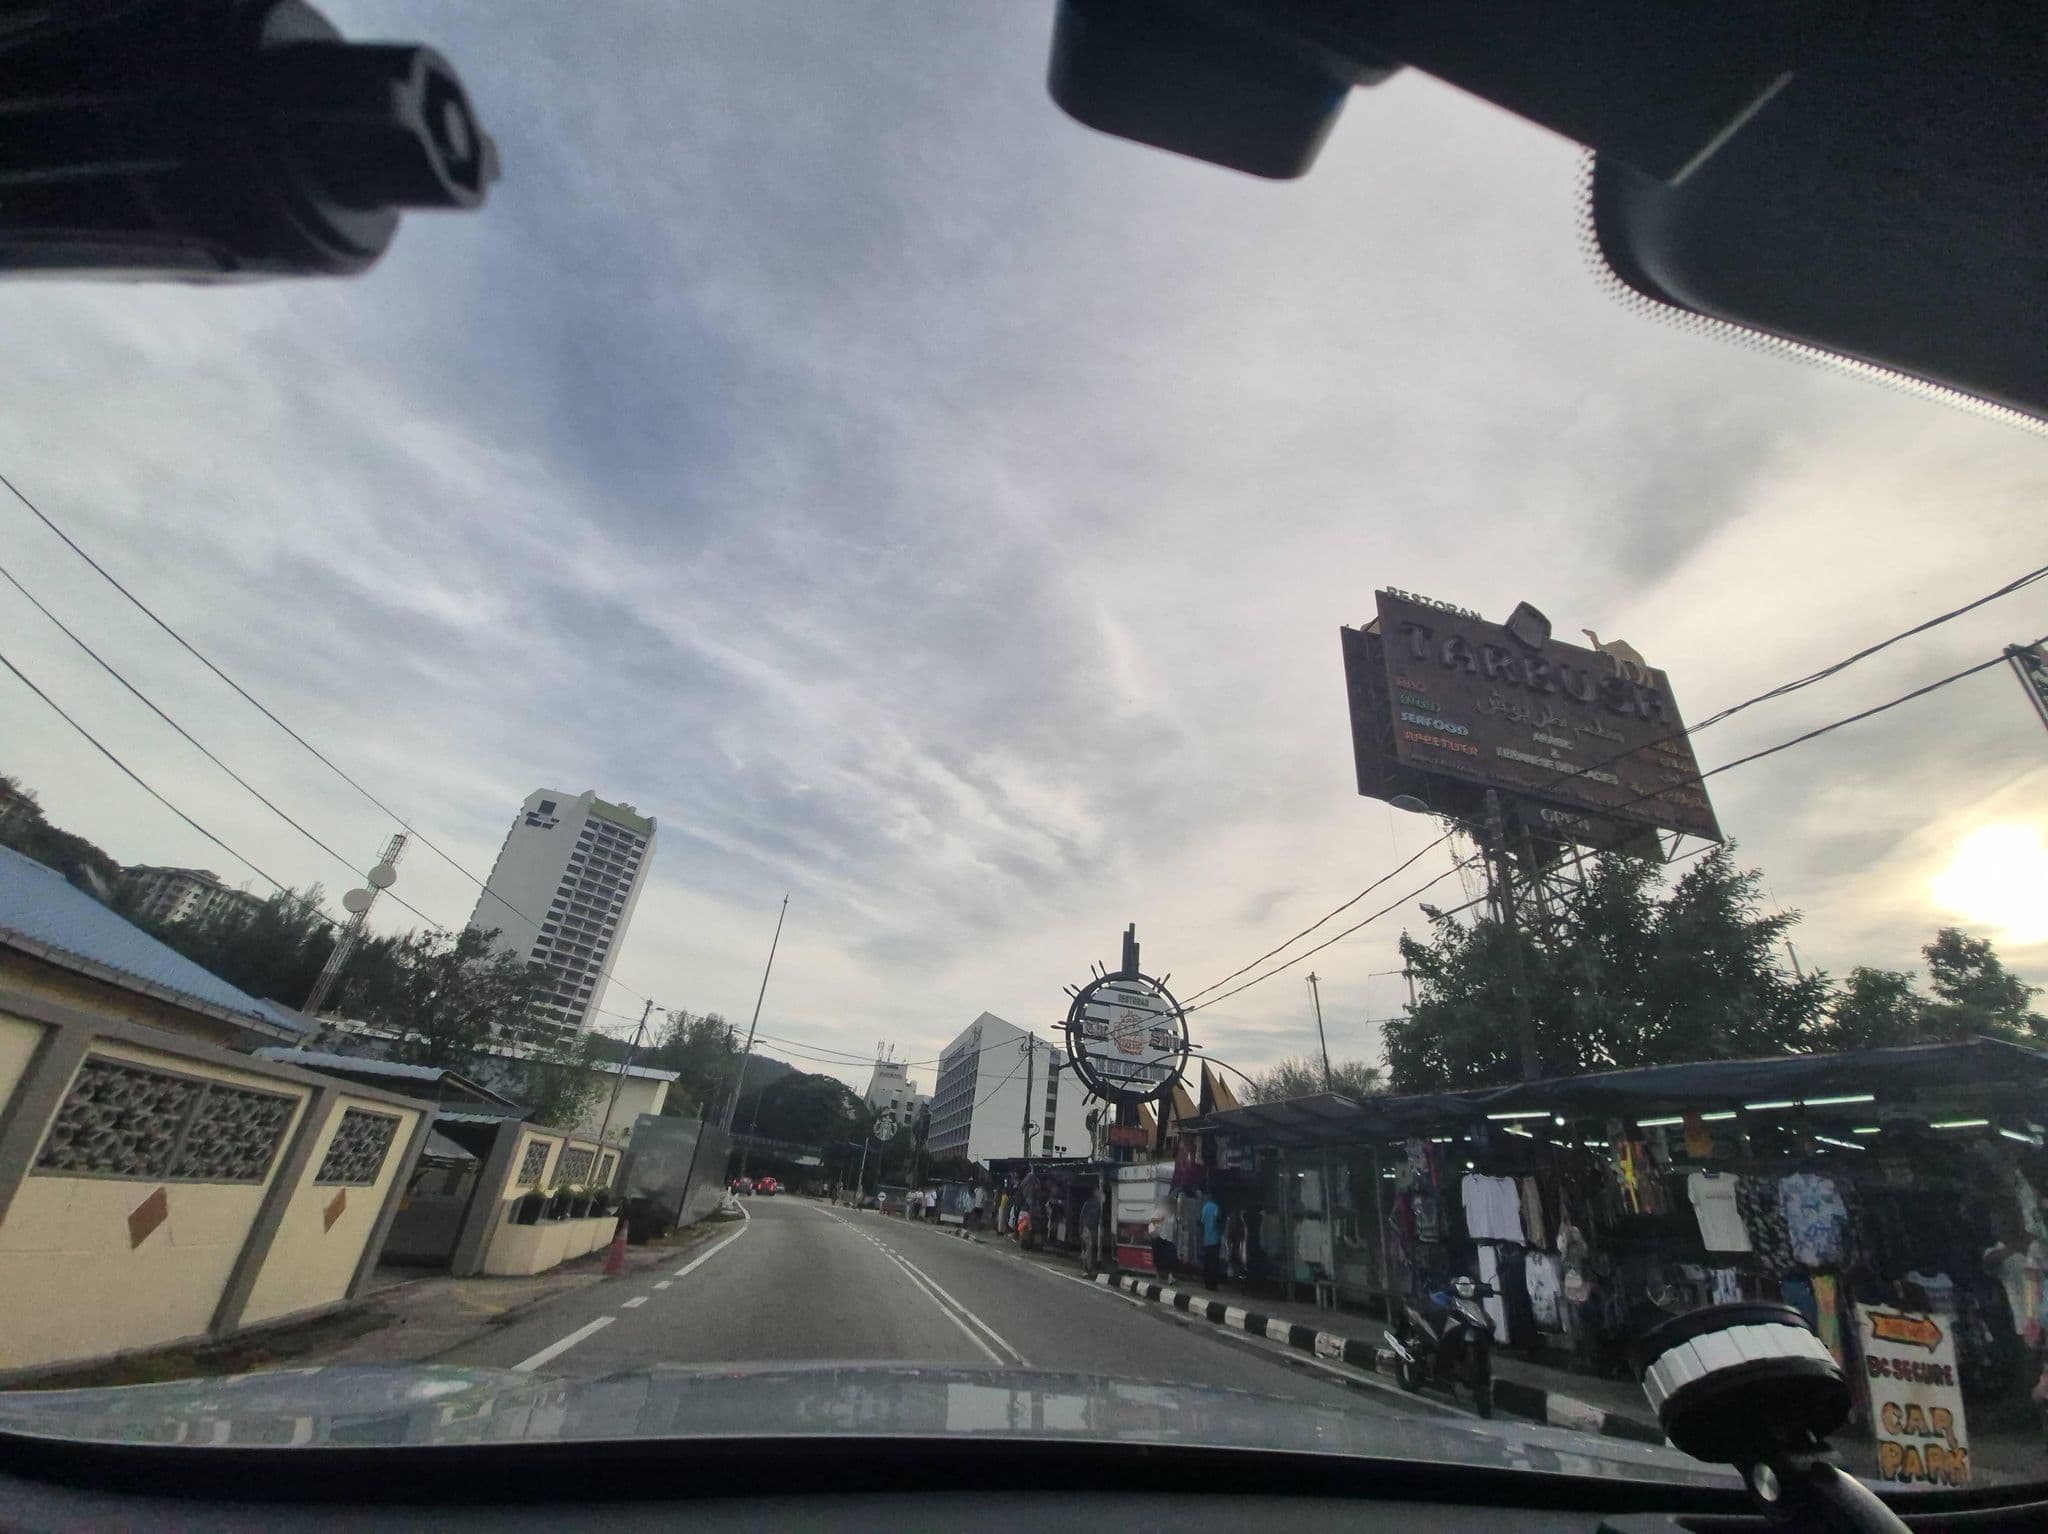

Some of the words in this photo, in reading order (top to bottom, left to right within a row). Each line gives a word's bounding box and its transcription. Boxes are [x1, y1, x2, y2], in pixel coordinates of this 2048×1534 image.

[1386, 586, 1483, 623] RESTORAN
[1881, 1401, 1959, 1450] CAR
[1878, 1440, 1968, 1487] PARK
